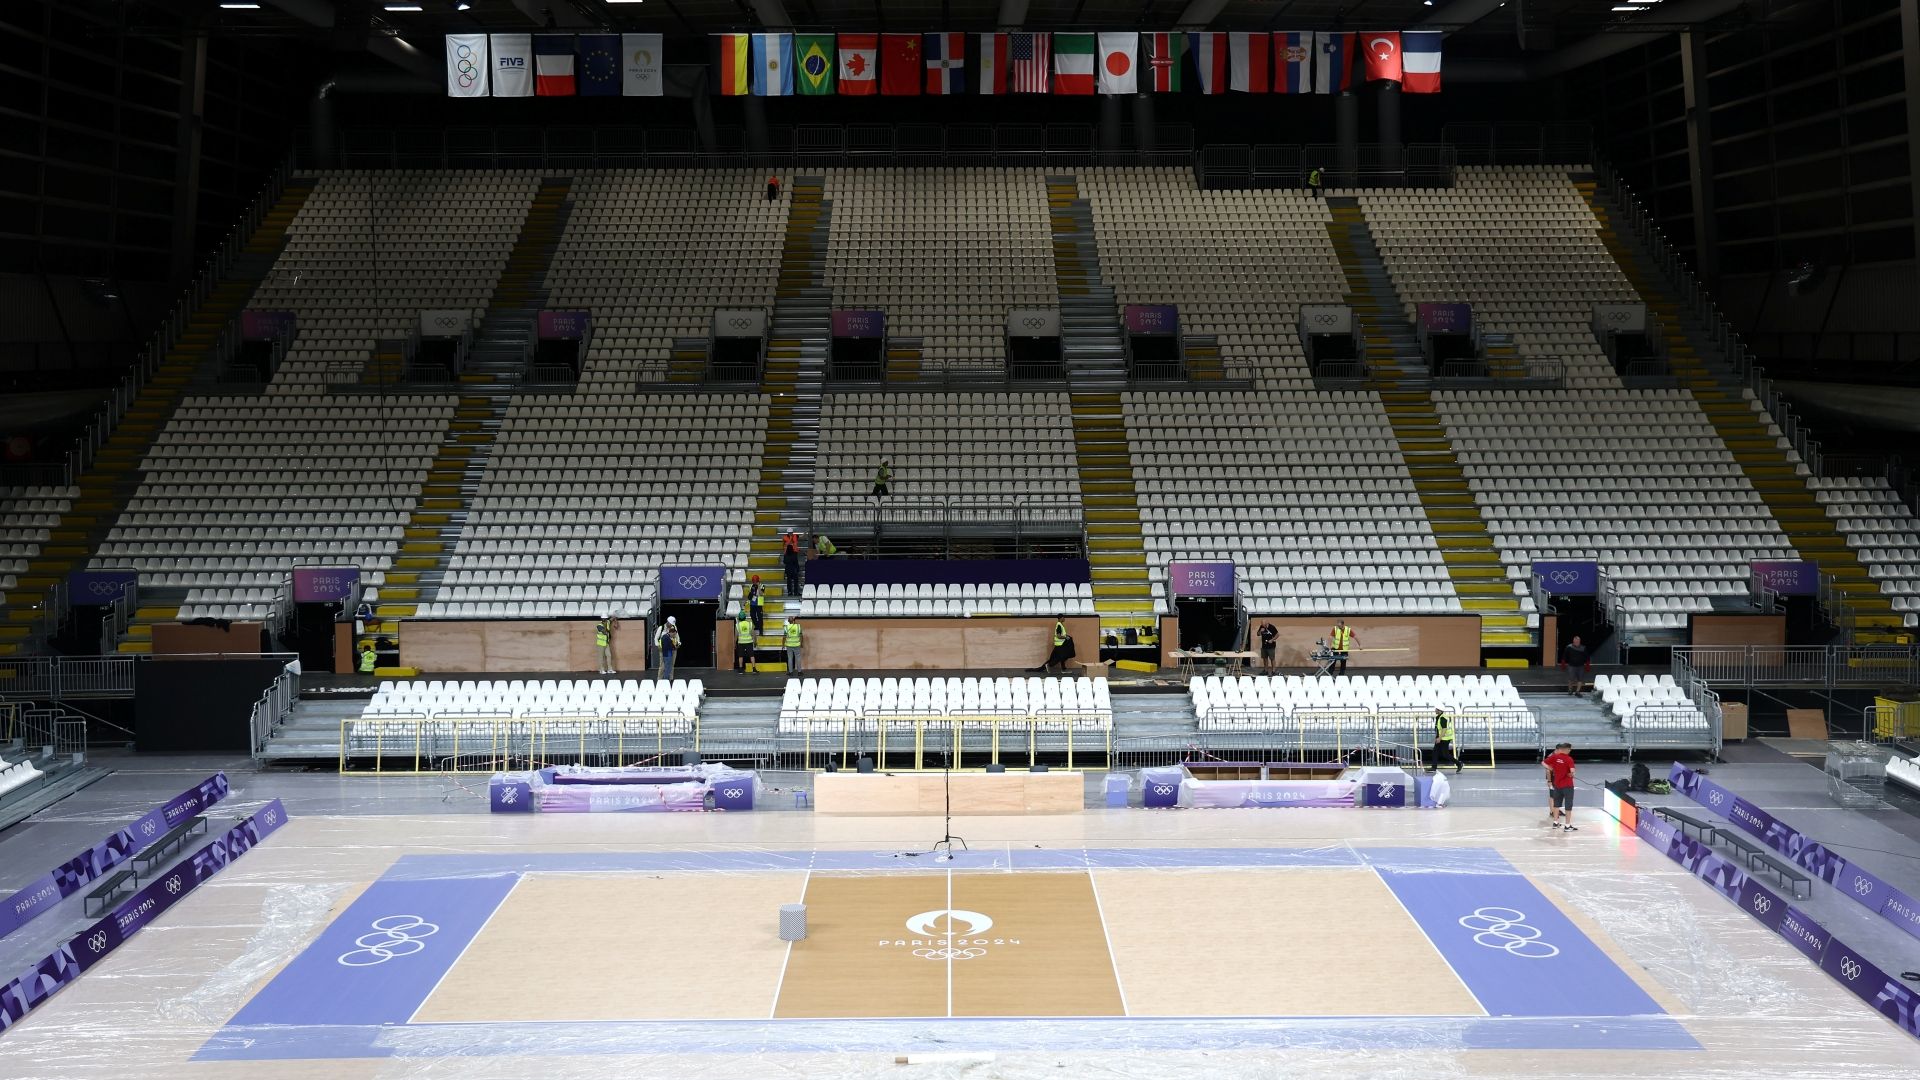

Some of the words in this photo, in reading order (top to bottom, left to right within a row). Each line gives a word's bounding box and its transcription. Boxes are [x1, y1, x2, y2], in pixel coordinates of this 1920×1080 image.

[500, 57, 524, 66] FIVB
[312, 576, 340, 584] PARIS
[1188, 571, 1215, 579] PARIS
[1188, 579, 1215, 587] 2024
[1770, 578, 1798, 586] 2024
[312, 585, 340, 593] 2024
[1276, 792, 1305, 800] 2024
[168, 805, 184, 818] PARIS
[184, 798, 198, 810] 2024
[1734, 806, 1750, 820] PARIS
[1749, 815, 1764, 829] 2024
[1640, 819, 1655, 834] PARIS
[15, 896, 37, 913] PARIS
[37, 885, 55, 901] 2024
[120, 909, 139, 928] PARIS
[138, 898, 156, 914] 2024
[1887, 898, 1910, 918] PARIS
[1785, 917, 1805, 937] PARIS
[1804, 931, 1822, 951] 2024
